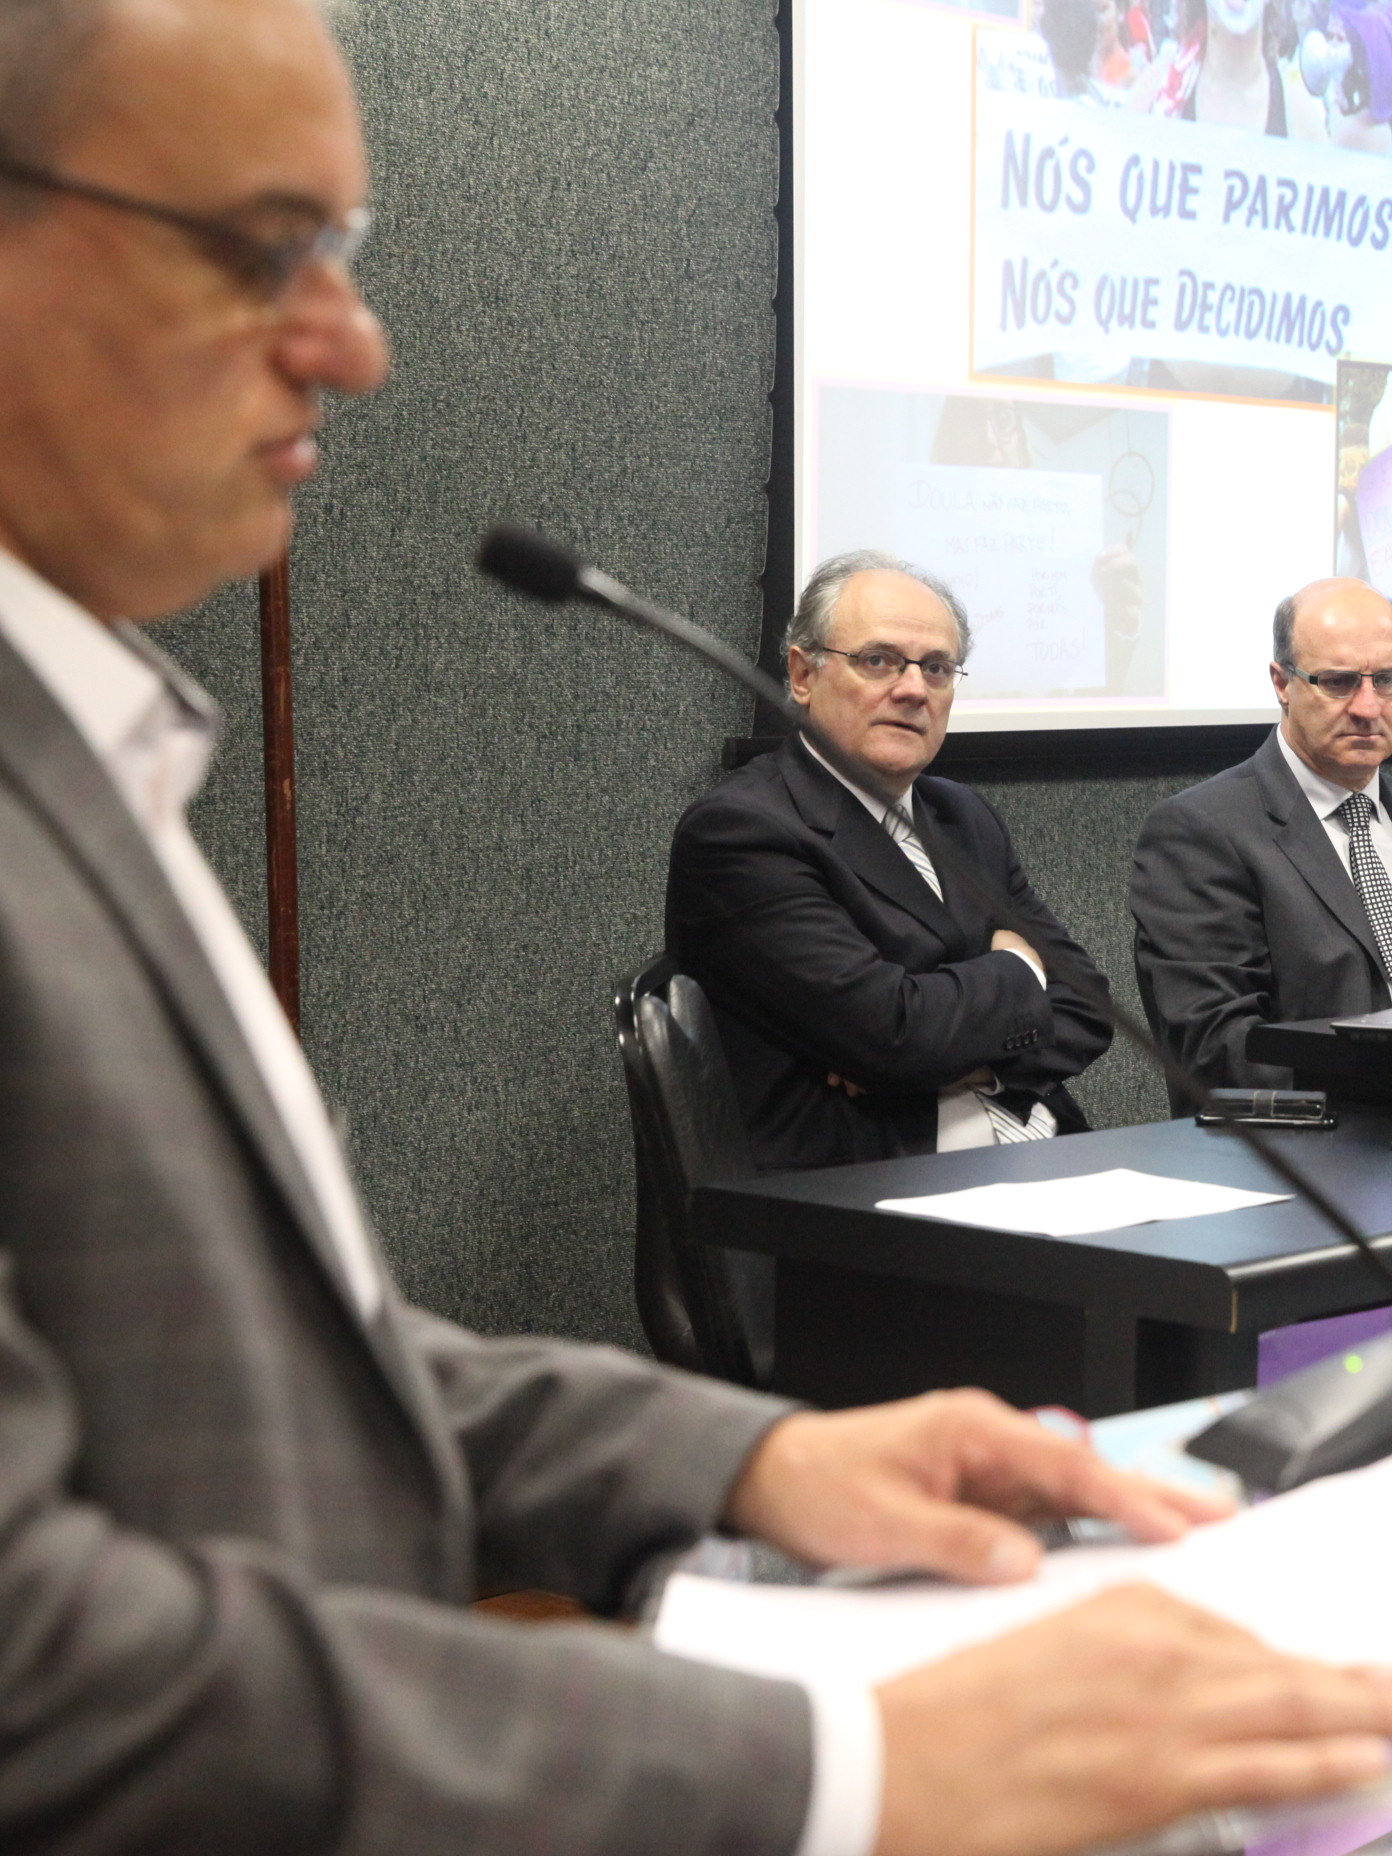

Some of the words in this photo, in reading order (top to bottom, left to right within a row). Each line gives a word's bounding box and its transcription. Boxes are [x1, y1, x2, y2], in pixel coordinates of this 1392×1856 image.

[1001, 129, 1096, 214] NÓS
[1119, 155, 1203, 222] QUE
[1000, 256, 1078, 332] NÓS
[1094, 273, 1160, 335] QUE
[908, 479, 976, 511] DOULA
